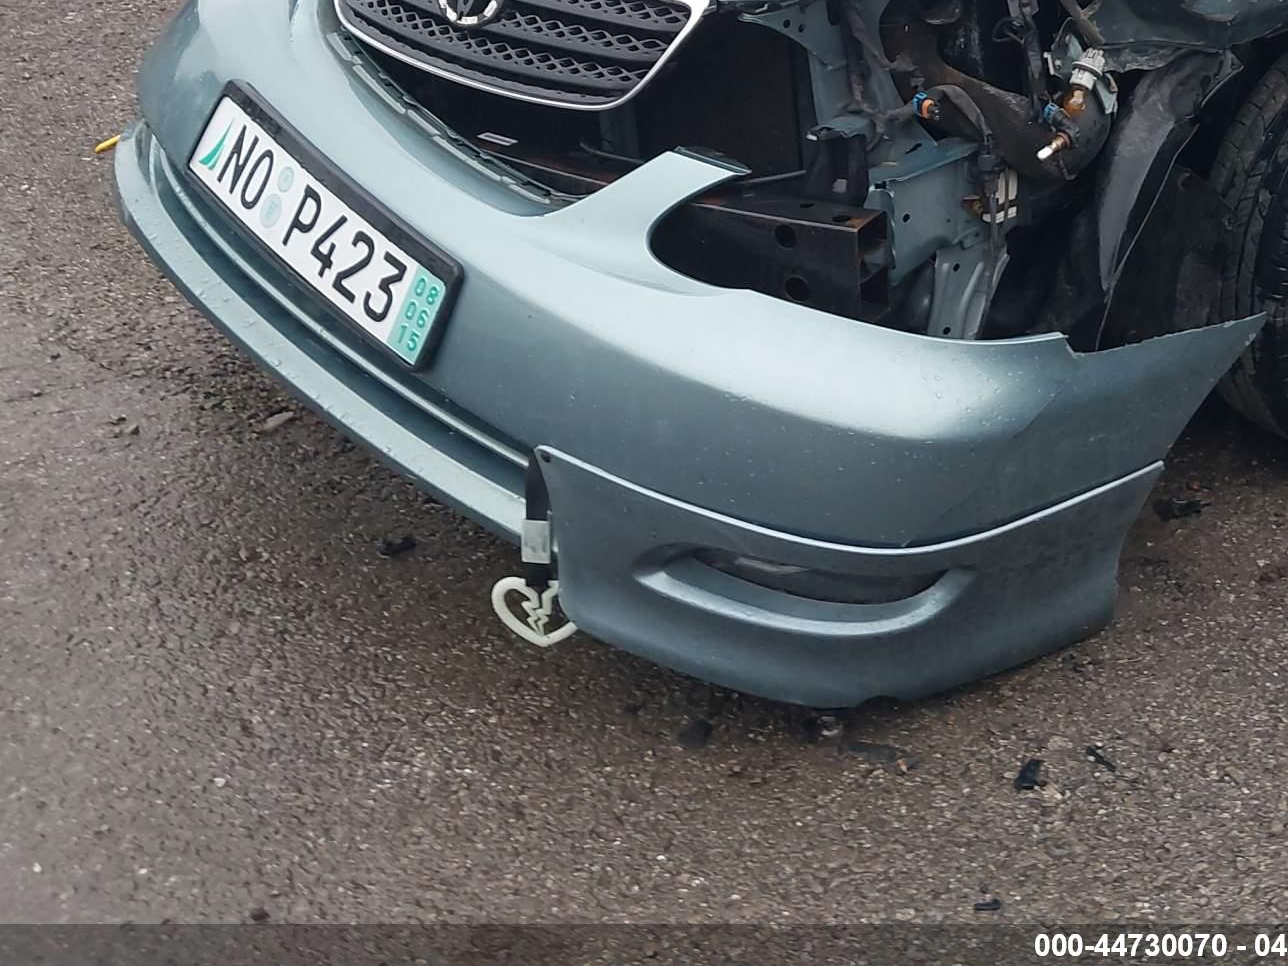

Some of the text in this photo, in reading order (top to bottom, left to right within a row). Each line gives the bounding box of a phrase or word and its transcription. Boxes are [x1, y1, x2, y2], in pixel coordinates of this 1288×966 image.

[217, 124, 408, 323] NO P423
[415, 277, 439, 305] 08
[405, 301, 430, 328] 06
[398, 324, 420, 351] 15
